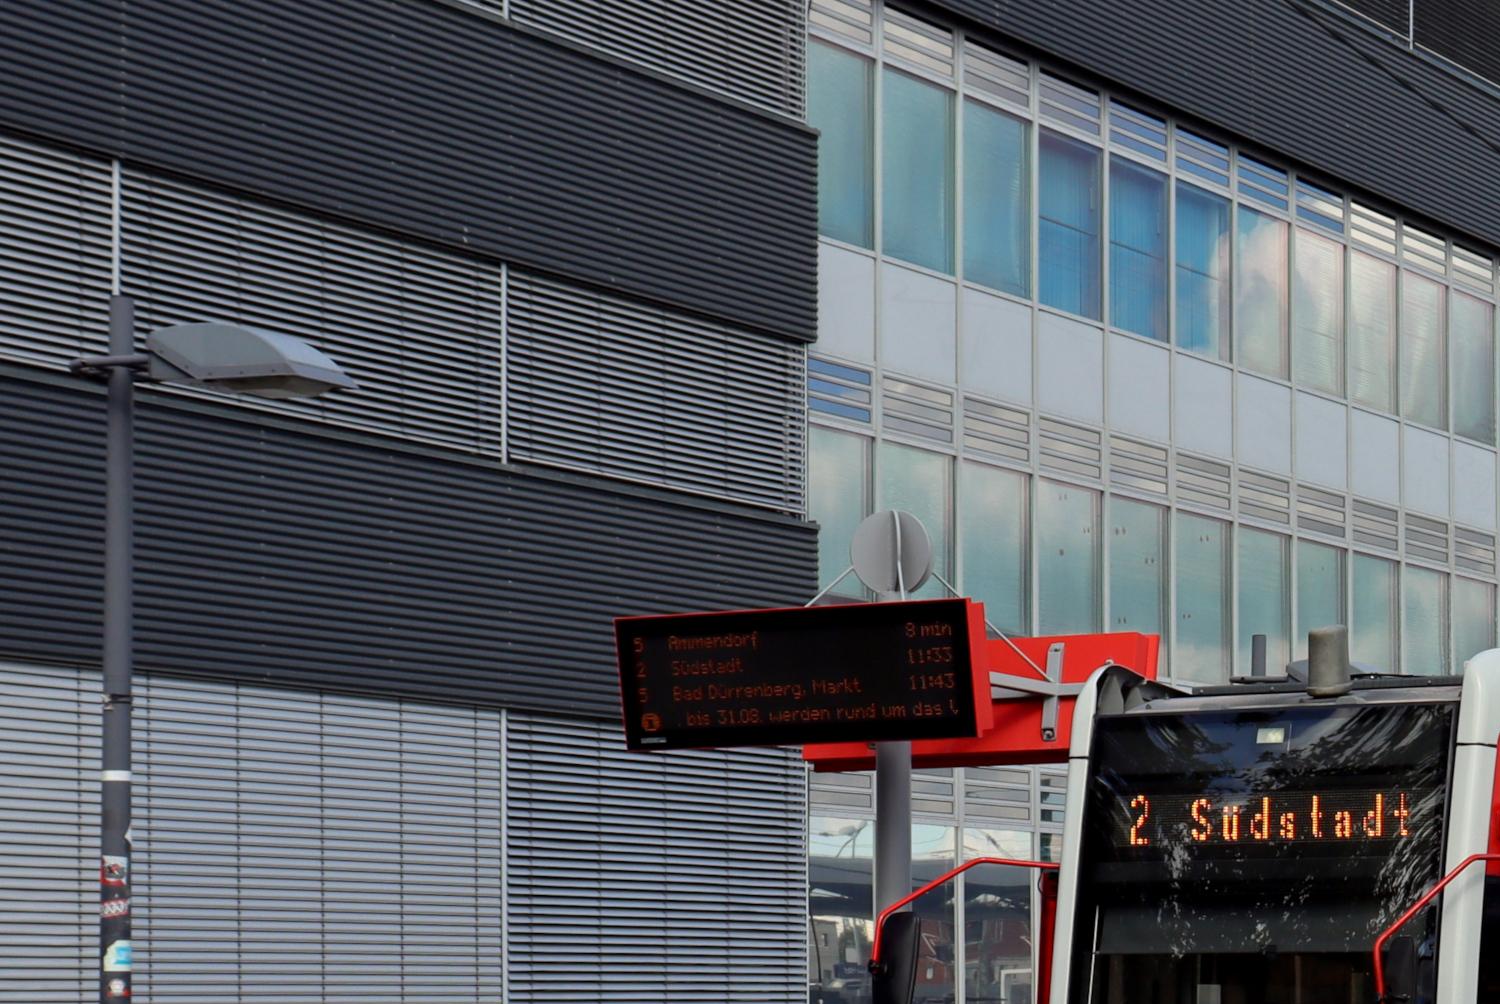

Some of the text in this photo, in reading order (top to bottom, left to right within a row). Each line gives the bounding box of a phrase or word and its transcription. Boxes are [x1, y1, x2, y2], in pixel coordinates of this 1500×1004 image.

[632, 637, 645, 653] 5
[668, 631, 759, 651] Ammendorf
[920, 622, 952, 637] min
[636, 664, 647, 678] 2
[907, 647, 953, 664] 11:33
[638, 687, 649, 703] 5
[672, 684, 704, 702] Bad
[812, 677, 863, 695] Markt
[909, 673, 955, 691] 11:43
[836, 703, 877, 719] rund
[881, 704, 907, 719] um
[912, 702, 944, 717] das
[1128, 792, 1410, 846] 2 Südstadt
